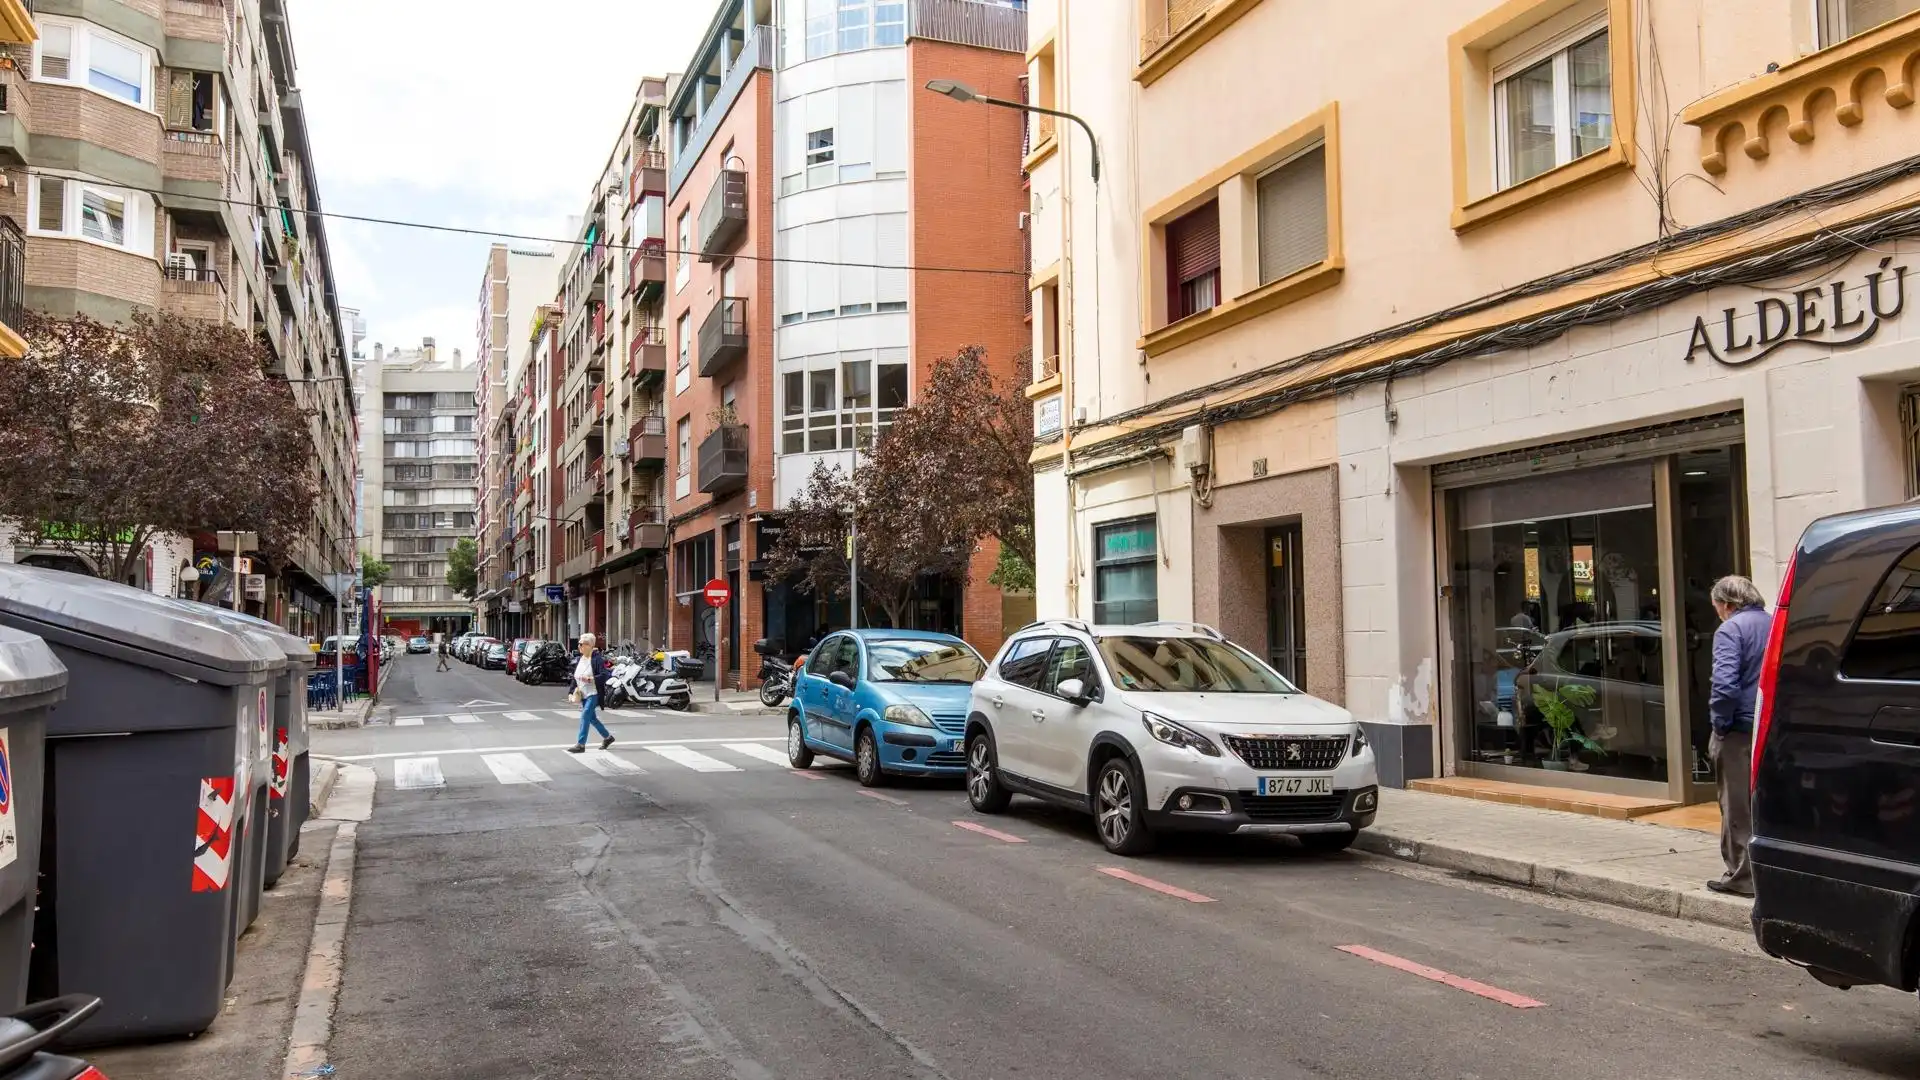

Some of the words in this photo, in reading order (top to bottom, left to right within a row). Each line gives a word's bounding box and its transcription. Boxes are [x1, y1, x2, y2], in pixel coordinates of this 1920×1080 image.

[1684, 257, 1907, 366] ALDELÚ
[1253, 460, 1265, 477] 20
[1269, 779, 1302, 793] 8747
[1307, 779, 1329, 793] JXL
